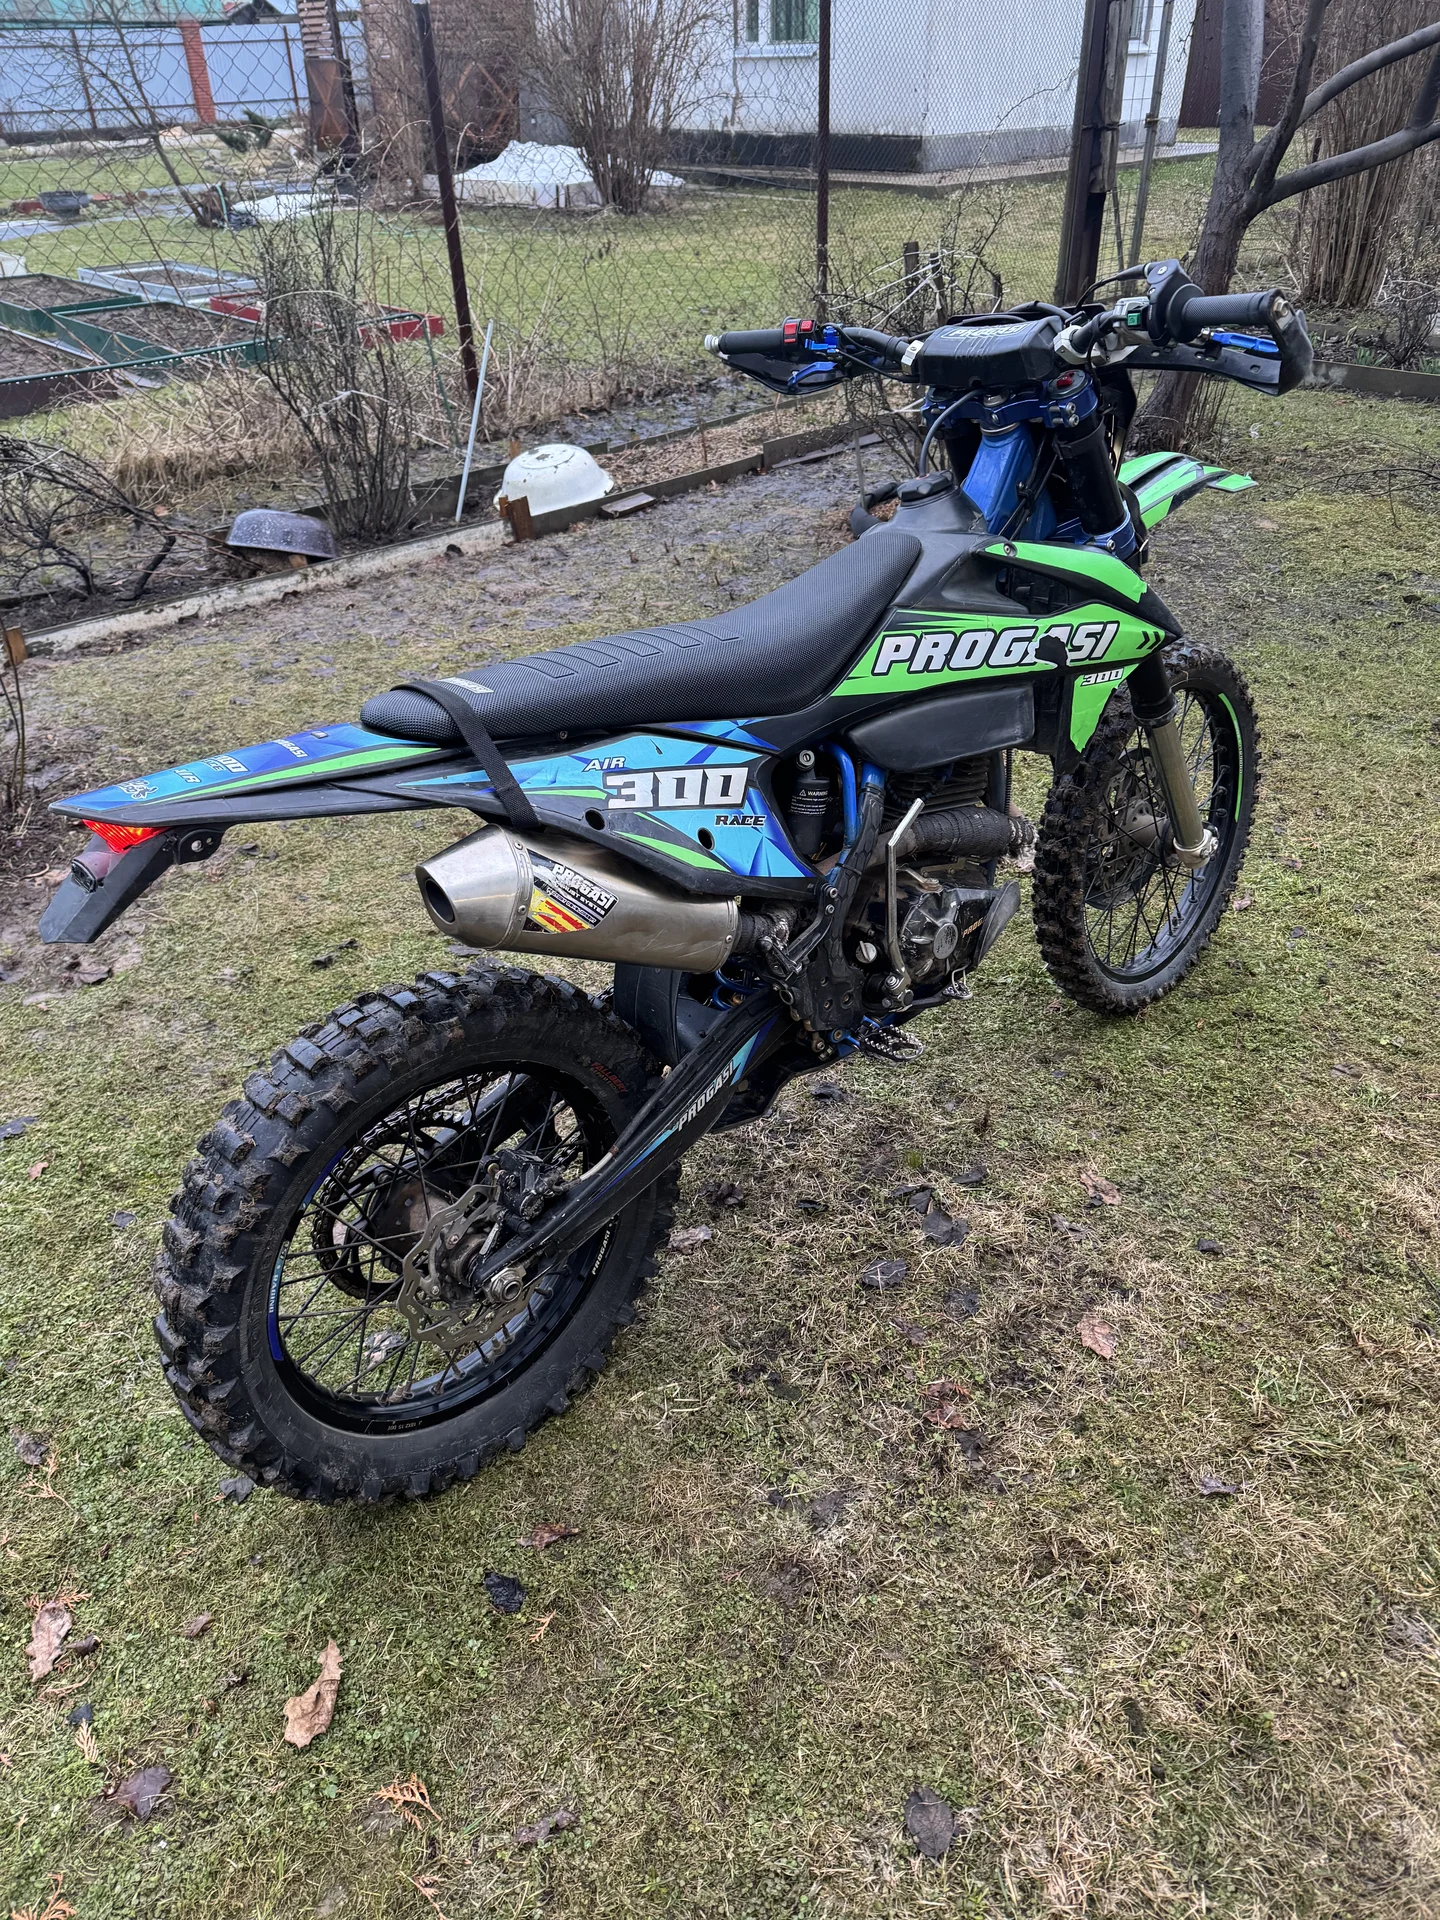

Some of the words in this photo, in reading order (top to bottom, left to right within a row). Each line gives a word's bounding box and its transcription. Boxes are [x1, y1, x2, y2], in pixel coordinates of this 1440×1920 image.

[1081, 668, 1124, 686] 300
[583, 756, 626, 772] AIR
[606, 767, 749, 809] 300
[715, 815, 767, 827] RACE
[552, 864, 617, 909] PROGASI
[962, 918, 984, 938] PROG
[678, 1059, 734, 1132] PROGASI
[591, 1230, 610, 1275] PROGASI
